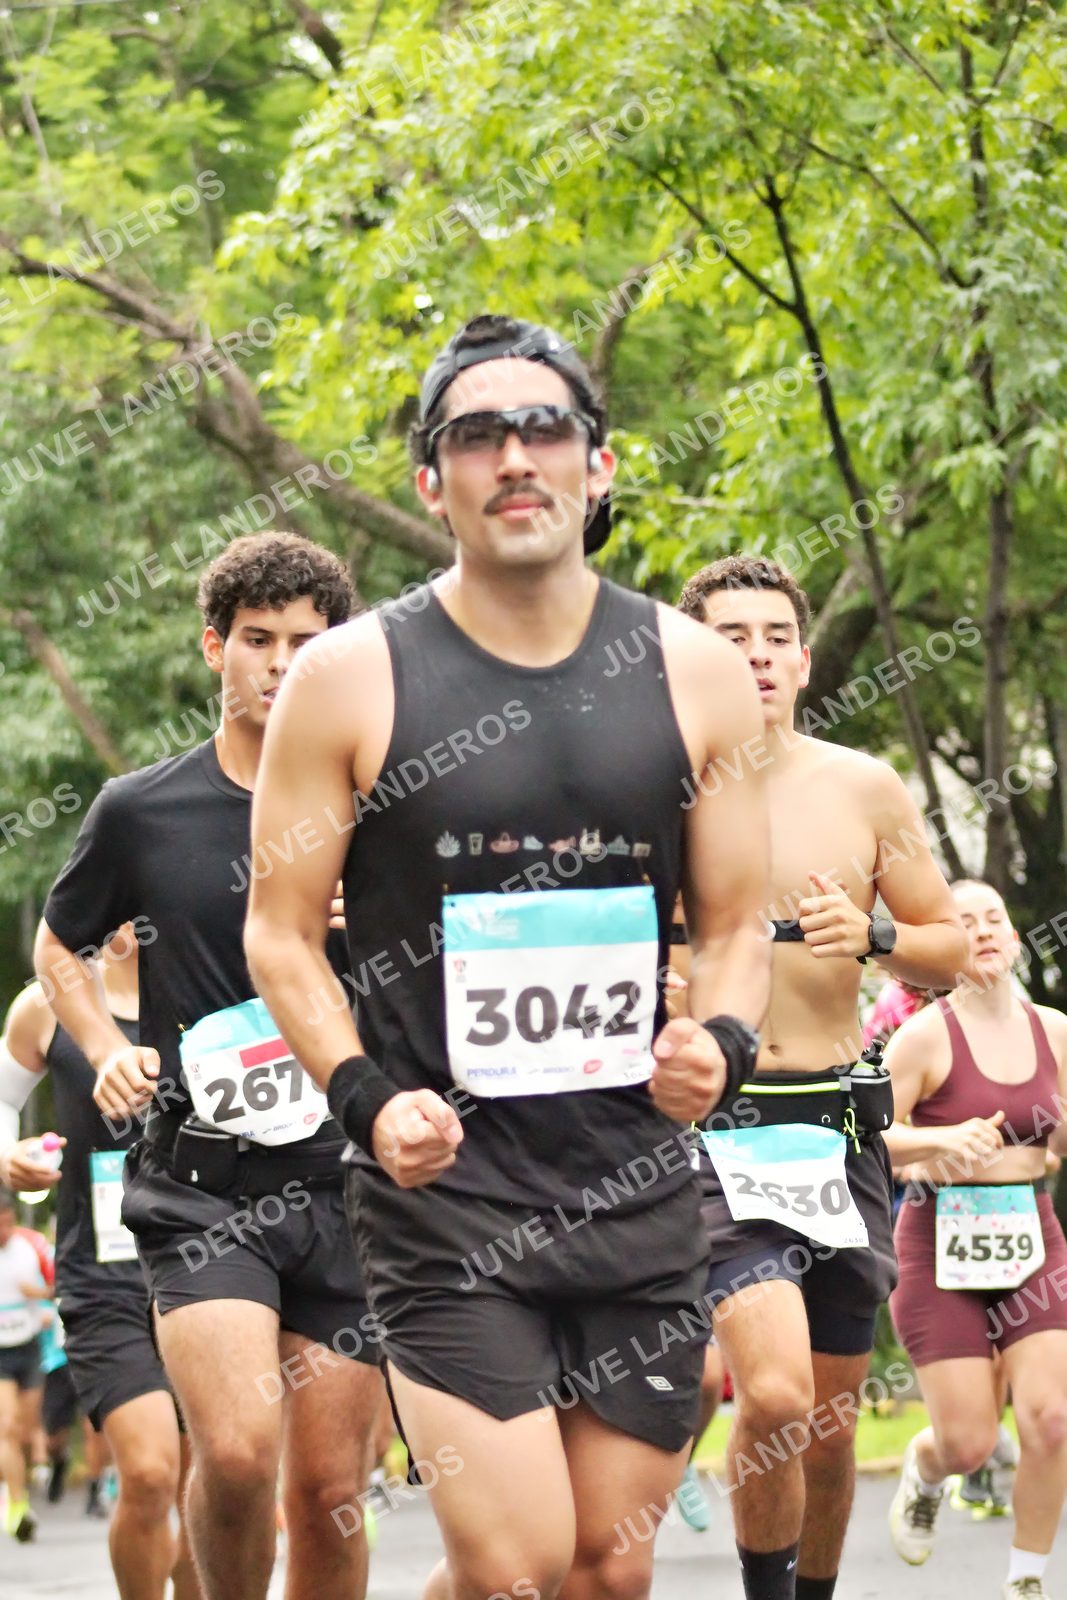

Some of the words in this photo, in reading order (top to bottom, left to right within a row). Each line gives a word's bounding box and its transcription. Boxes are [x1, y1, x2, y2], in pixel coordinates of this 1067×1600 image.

[466, 981, 641, 1046] 3042
[204, 1058, 327, 1123] 267
[729, 1172, 851, 1217] 2630
[947, 1233, 1034, 1261] 4539
